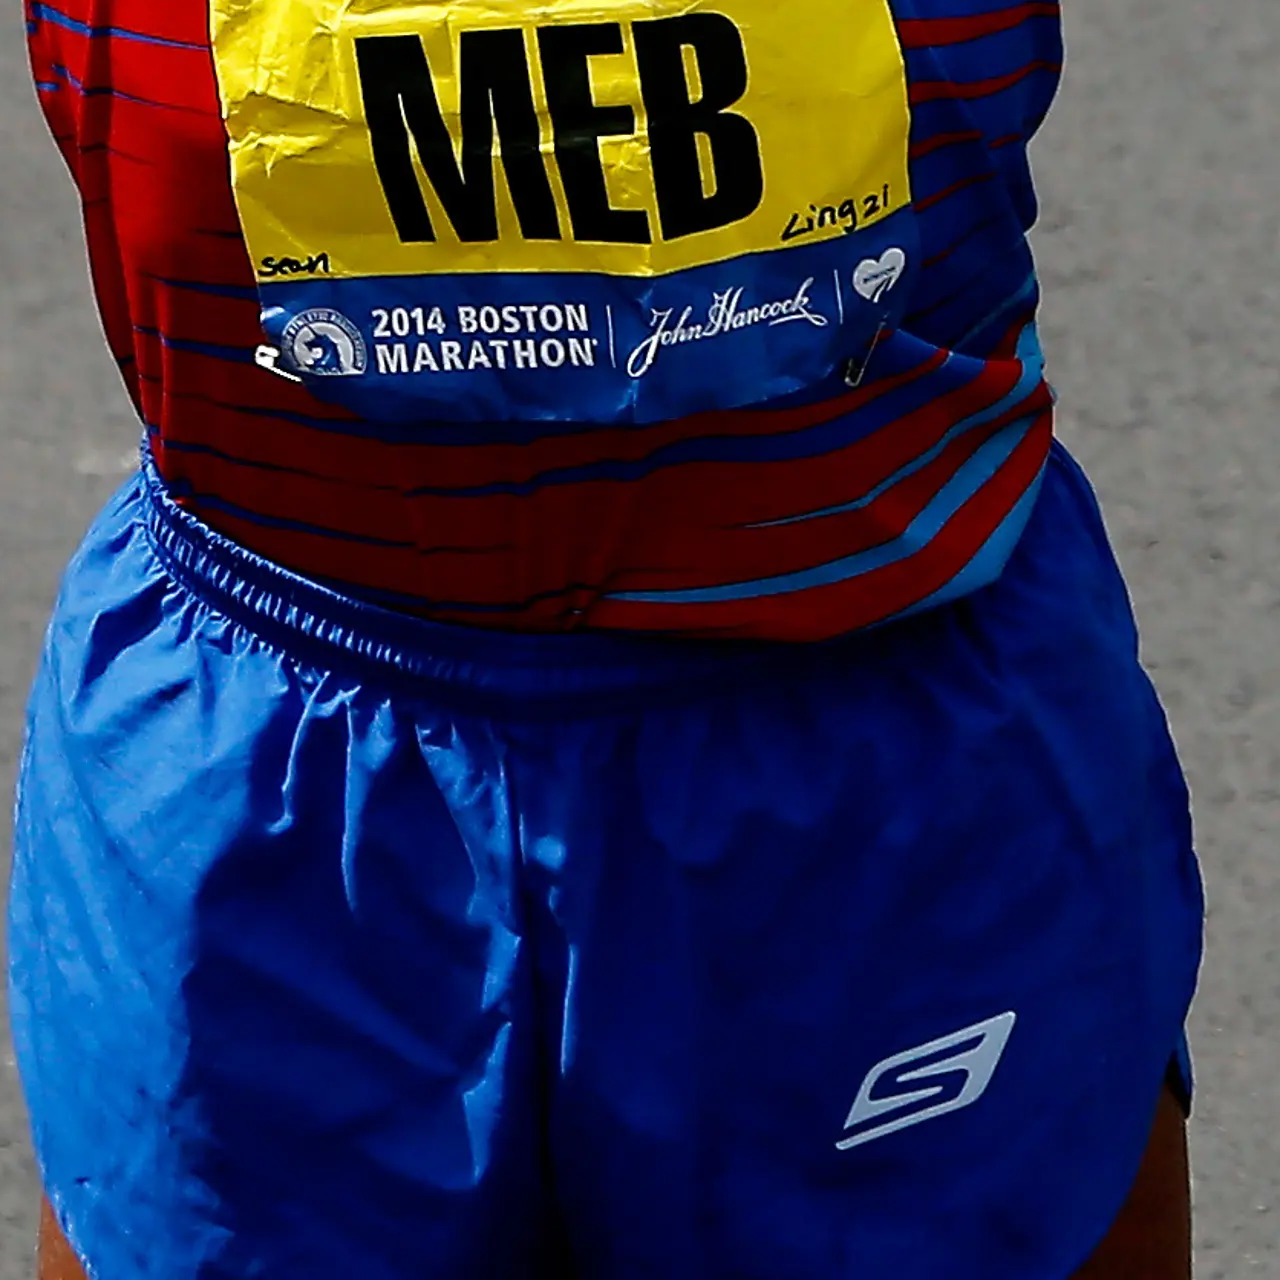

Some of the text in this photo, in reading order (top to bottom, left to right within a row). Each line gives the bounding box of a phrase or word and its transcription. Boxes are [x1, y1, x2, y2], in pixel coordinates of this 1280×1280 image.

[355, 11, 764, 245] MEB
[371, 303, 589, 338] 2014 BOSTON
[627, 277, 828, 378] John Hancock
[374, 337, 596, 375] MARATHON
